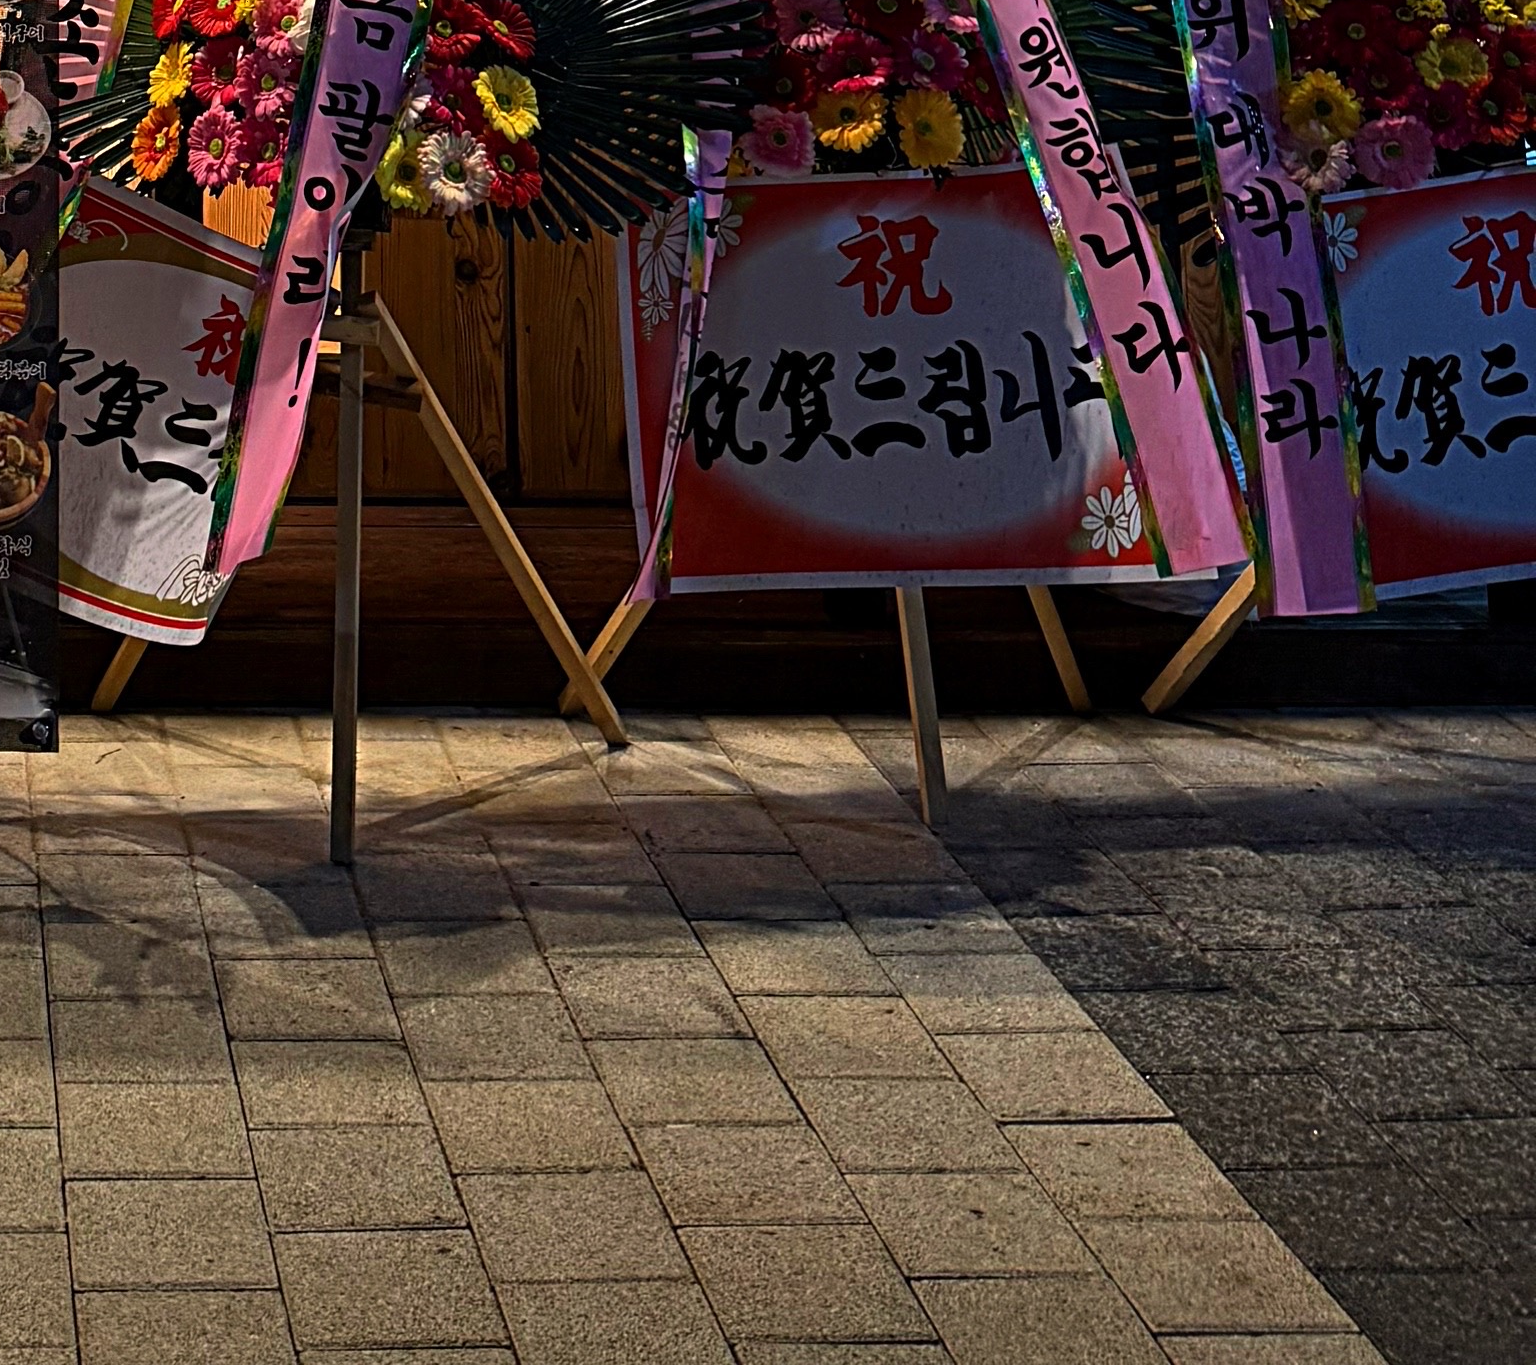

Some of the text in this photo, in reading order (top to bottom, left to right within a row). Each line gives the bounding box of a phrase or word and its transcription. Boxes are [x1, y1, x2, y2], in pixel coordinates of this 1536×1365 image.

[1207, 93, 1305, 257] 대박
[838, 214, 953, 319] 祝
[1246, 288, 1338, 460] 나라
